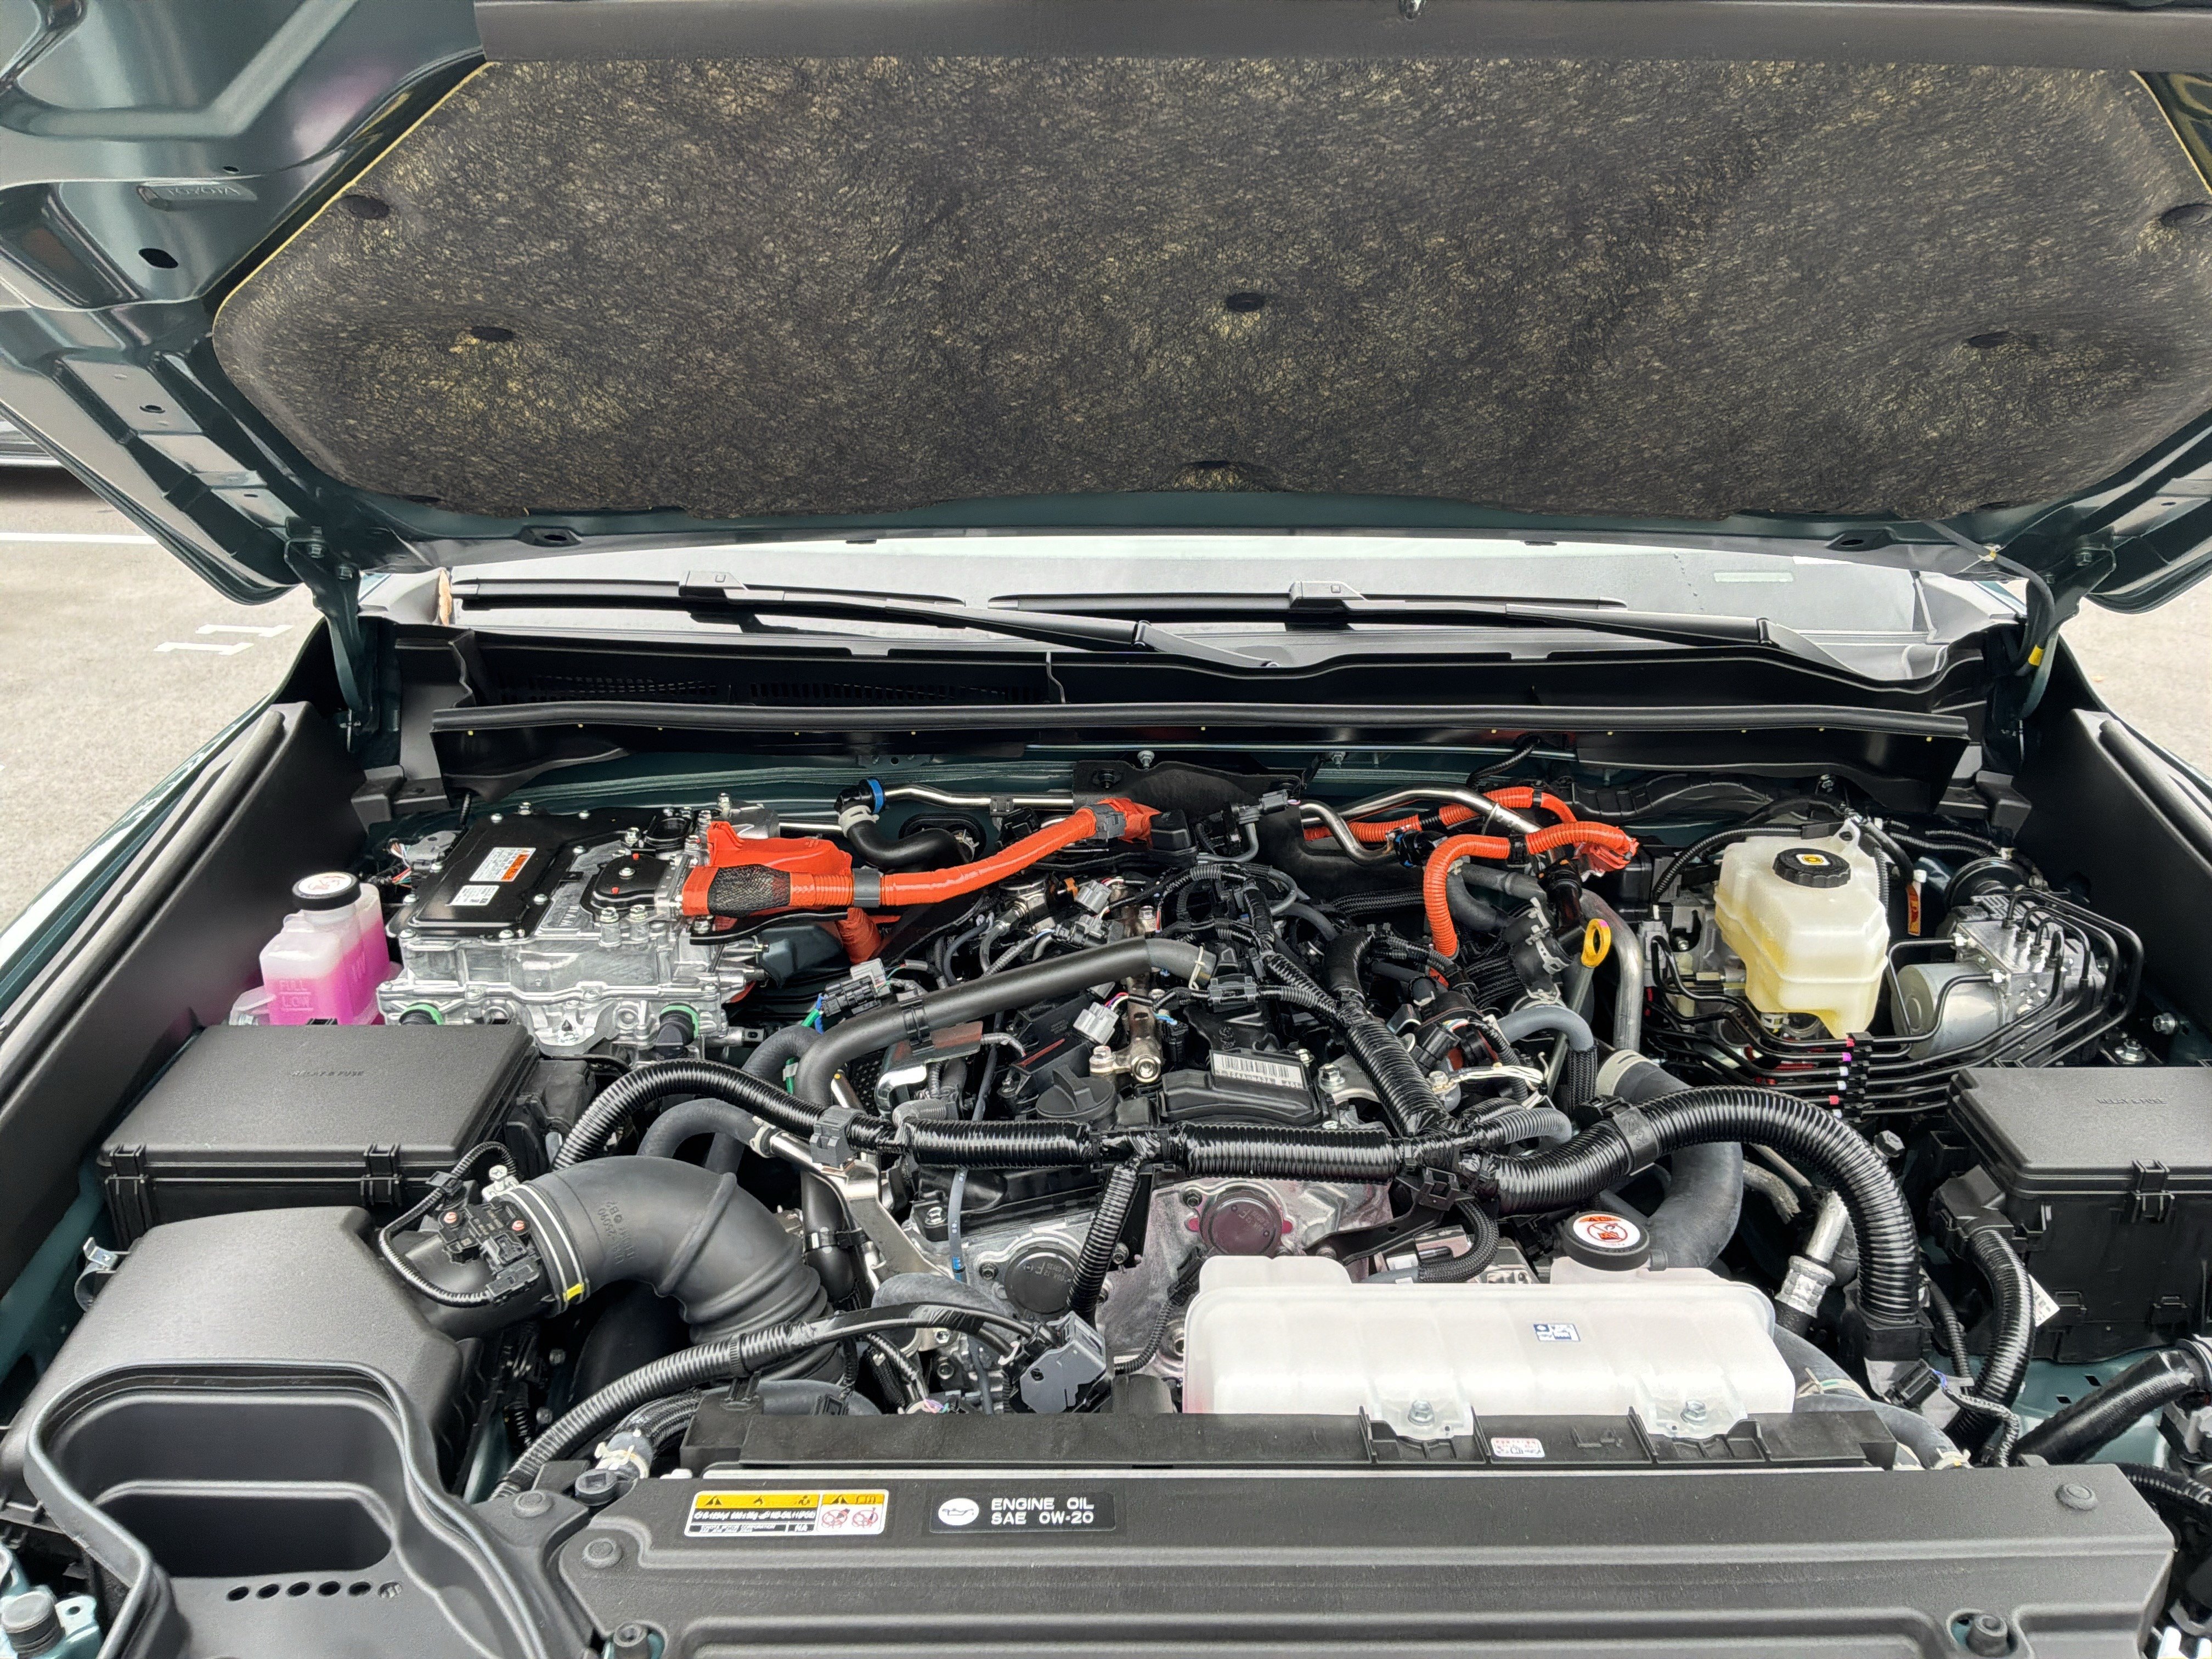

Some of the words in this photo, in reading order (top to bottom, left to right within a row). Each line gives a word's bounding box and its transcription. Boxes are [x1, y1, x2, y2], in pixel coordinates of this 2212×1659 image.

[991, 1497, 1055, 1510] ENGINE
[1066, 1497, 1095, 1510] OIL
[991, 1511, 1028, 1525] SAE
[1039, 1511, 1094, 1525] 0W-20
